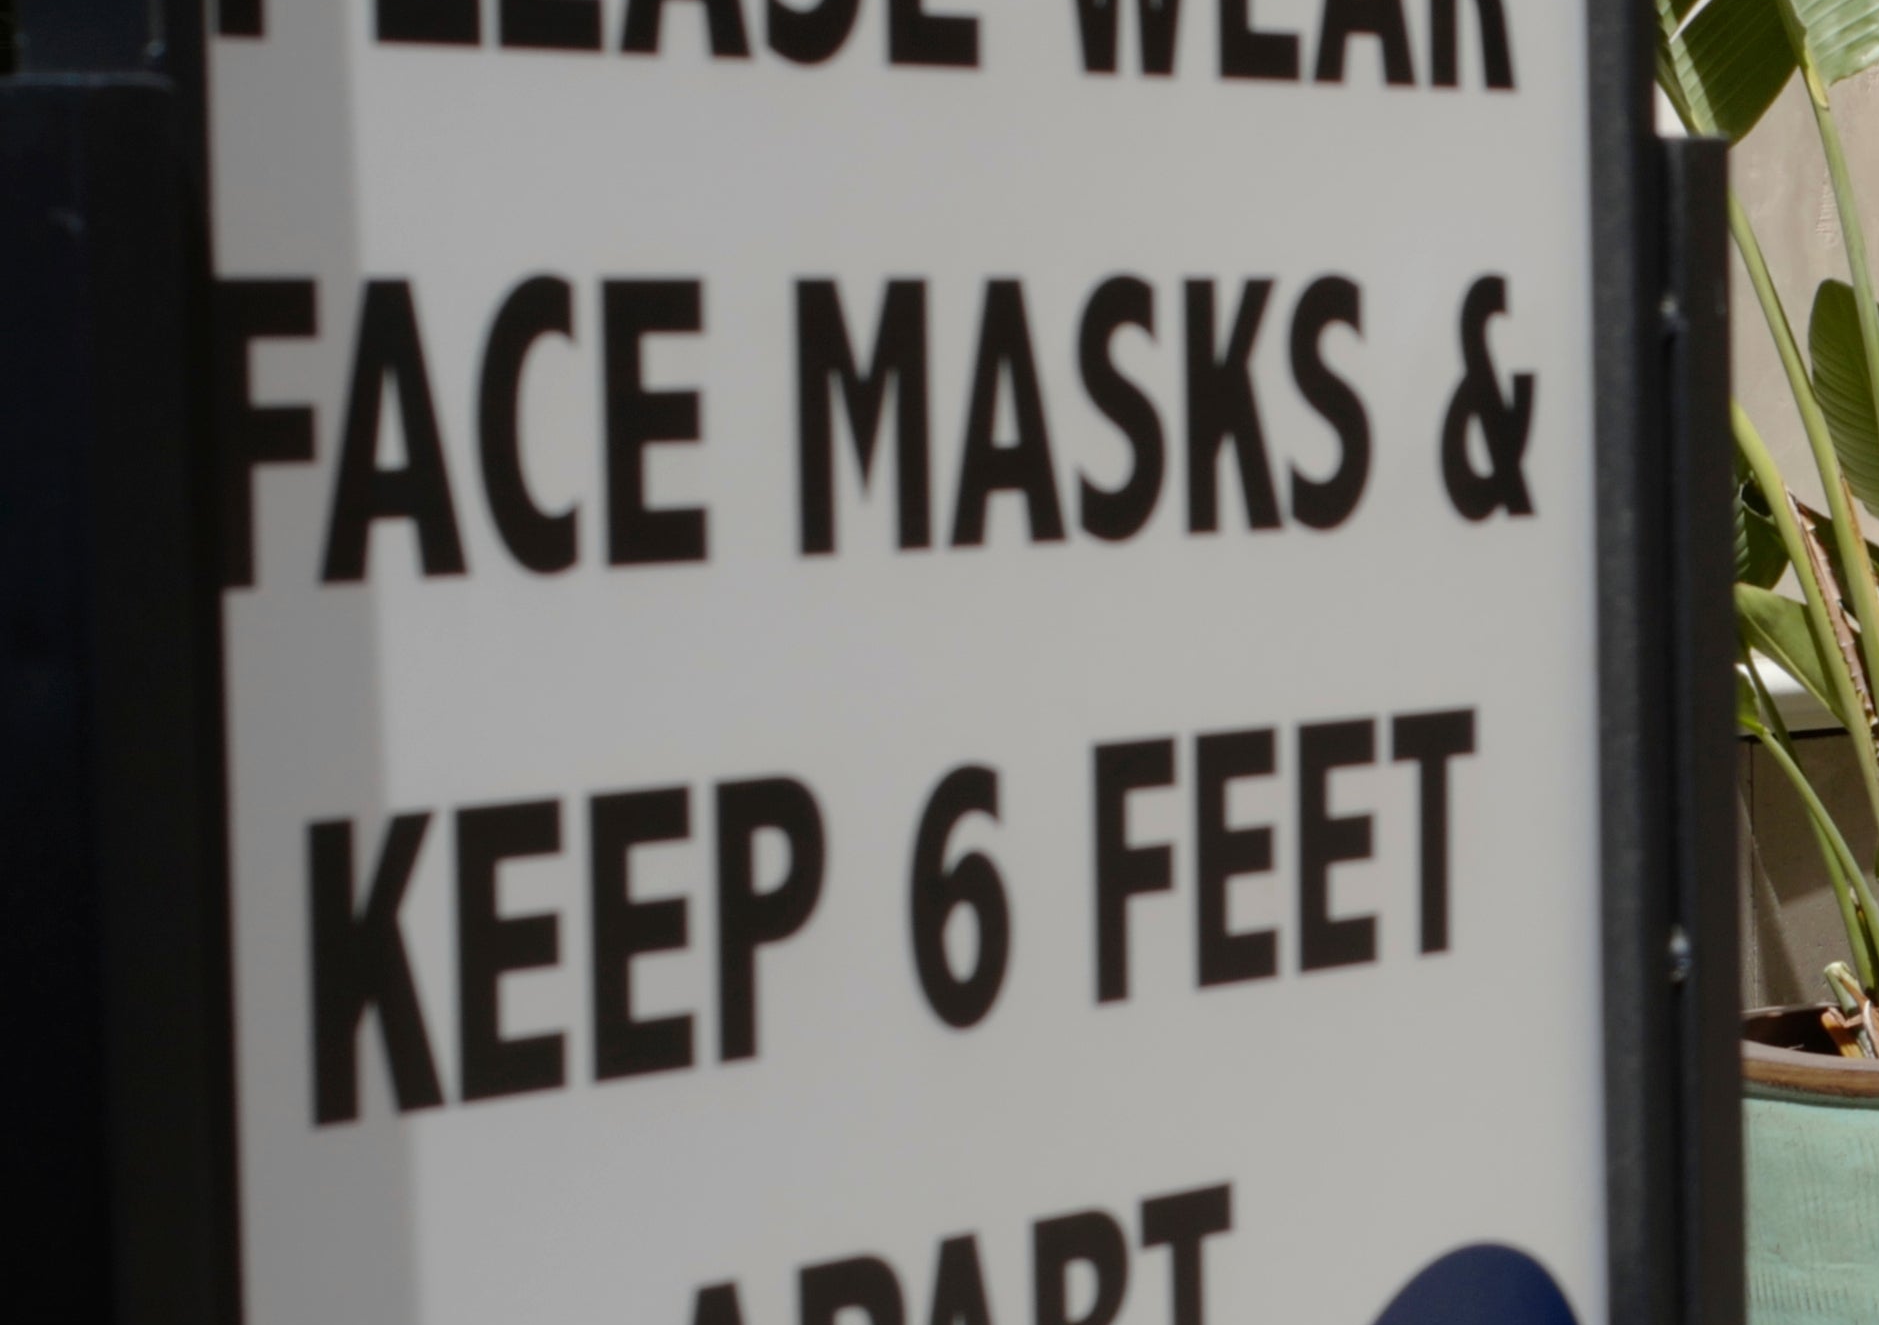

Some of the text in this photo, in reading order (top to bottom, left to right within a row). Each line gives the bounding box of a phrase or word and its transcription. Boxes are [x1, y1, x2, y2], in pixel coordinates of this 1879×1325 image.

[214, 274, 1538, 589] FACE MASKS &
[308, 707, 1477, 1126] KEEP 6 FEET
